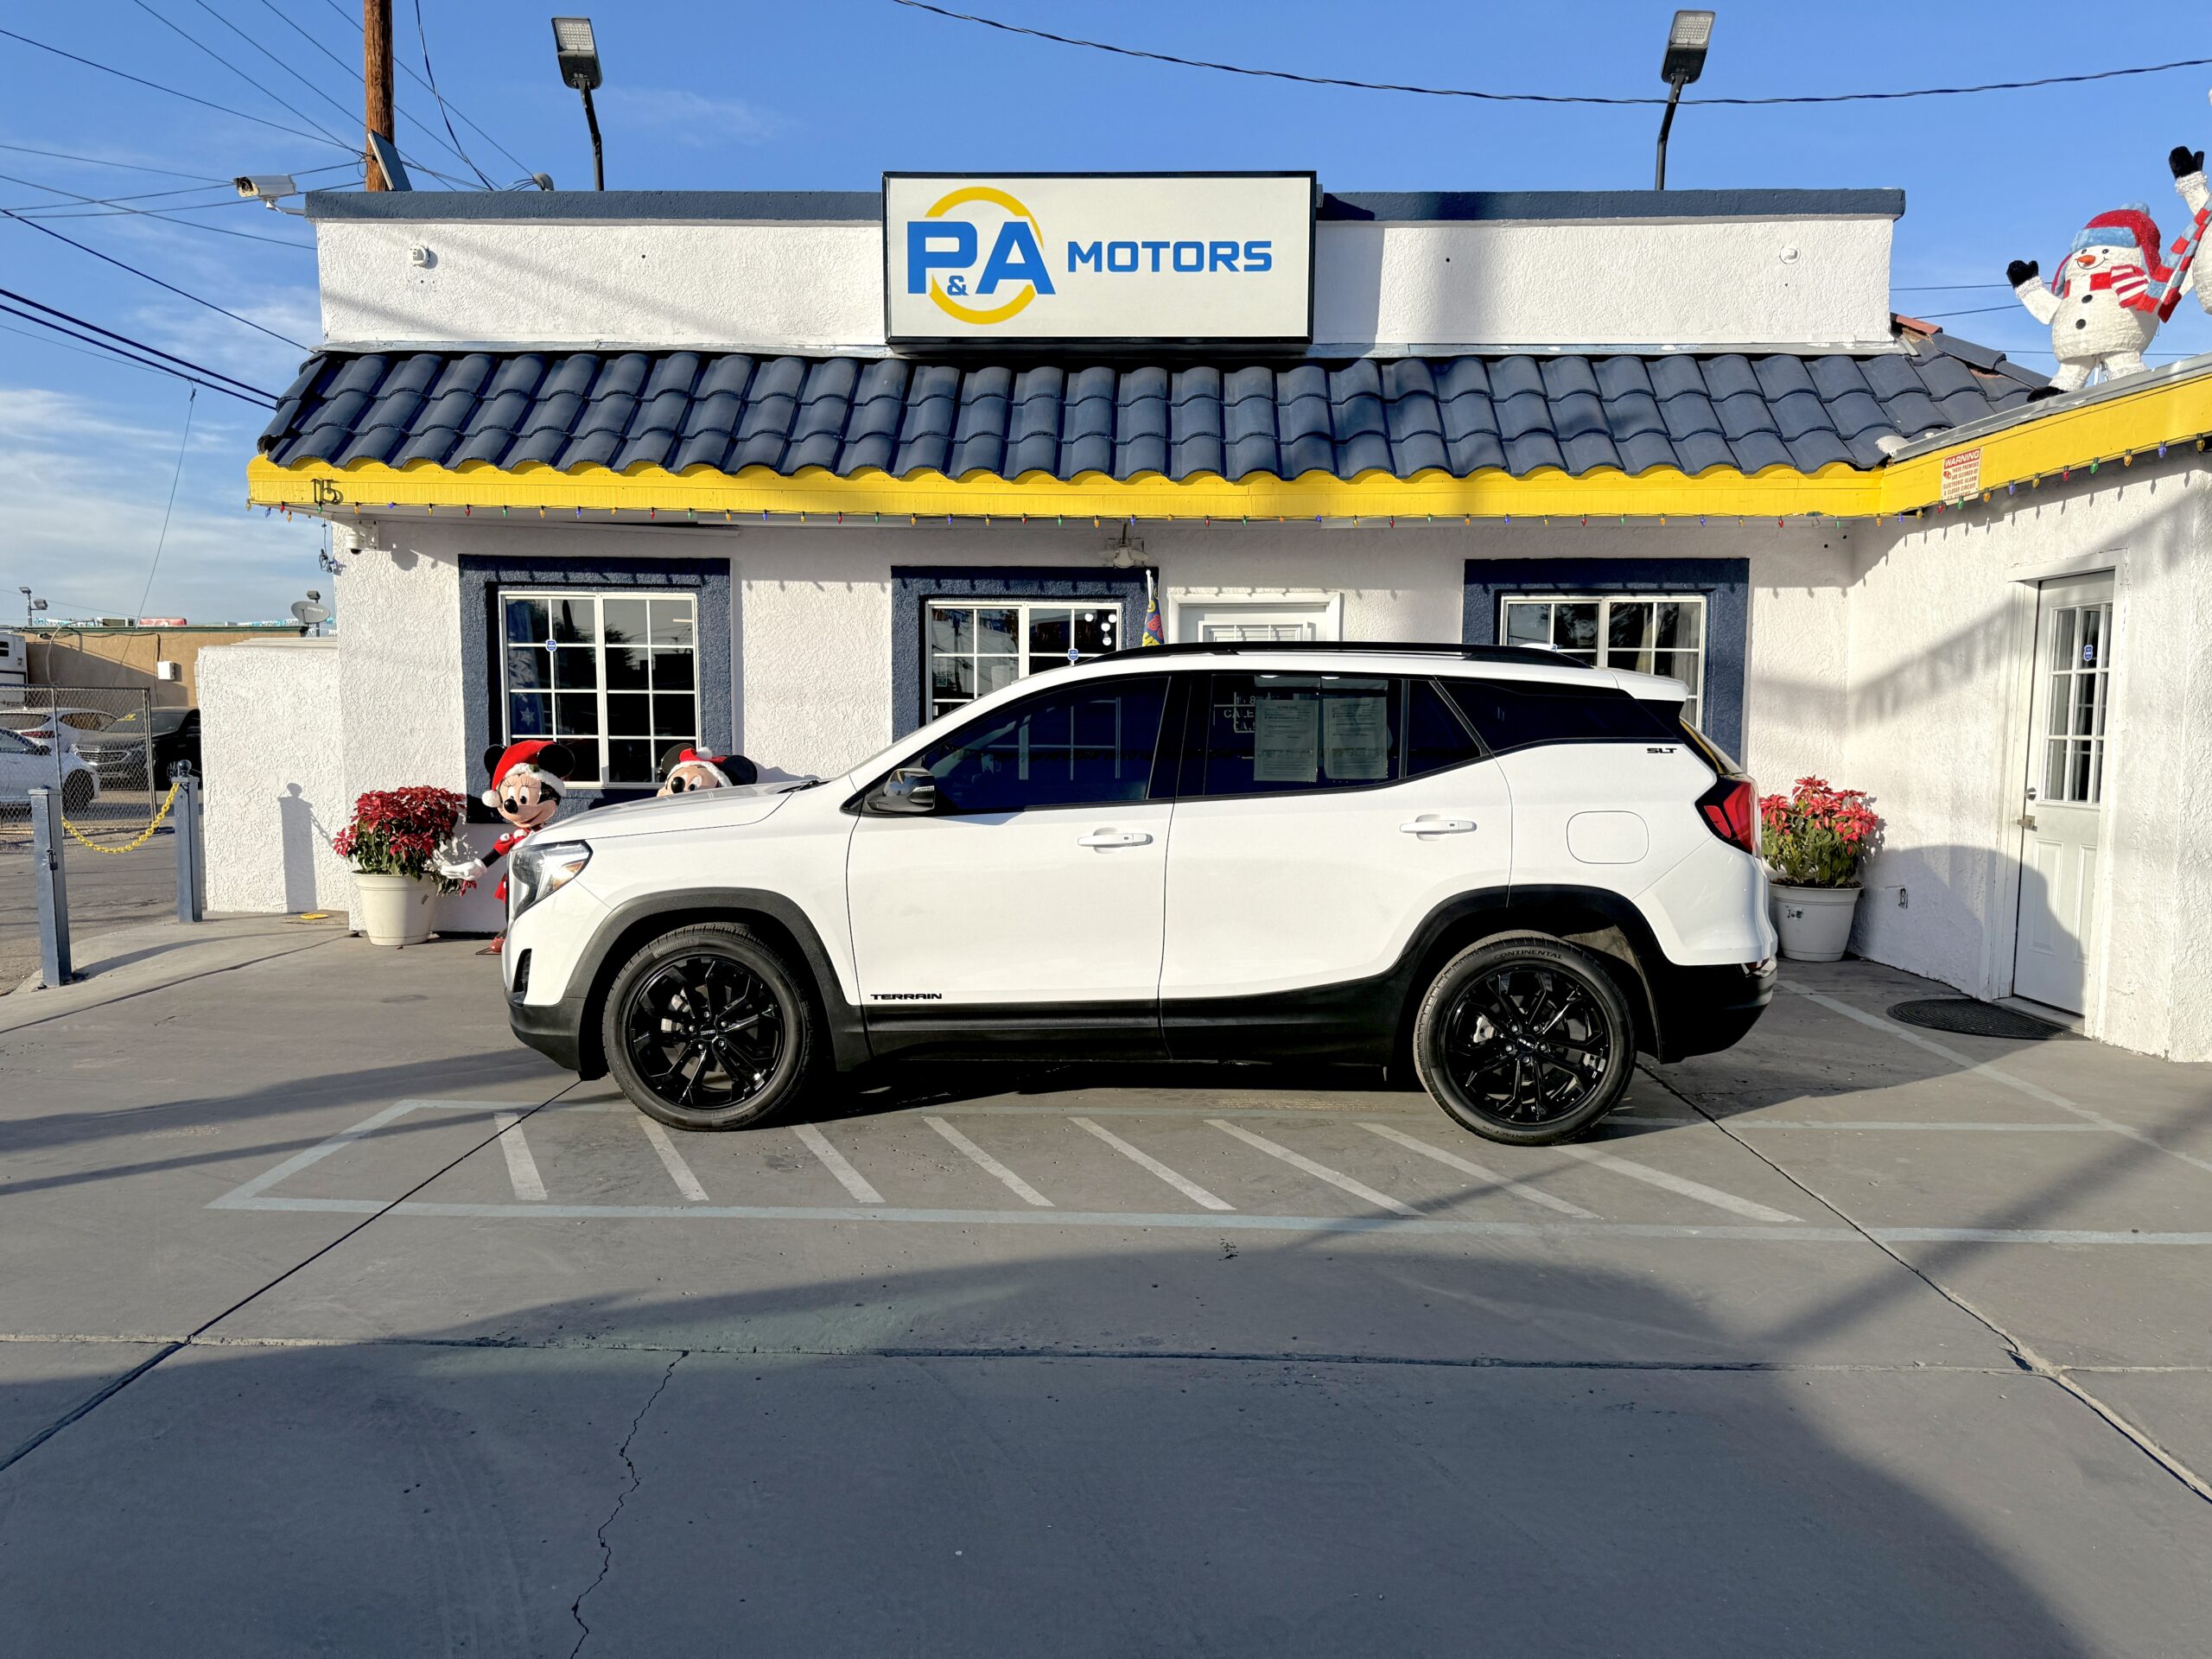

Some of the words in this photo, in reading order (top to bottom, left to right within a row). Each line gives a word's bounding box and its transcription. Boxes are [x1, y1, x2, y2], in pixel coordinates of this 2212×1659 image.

[1067, 241, 1272, 273] MOTORS
[1945, 450, 1980, 468] WARNING
[1493, 949, 1563, 960] CONTINENTAL
